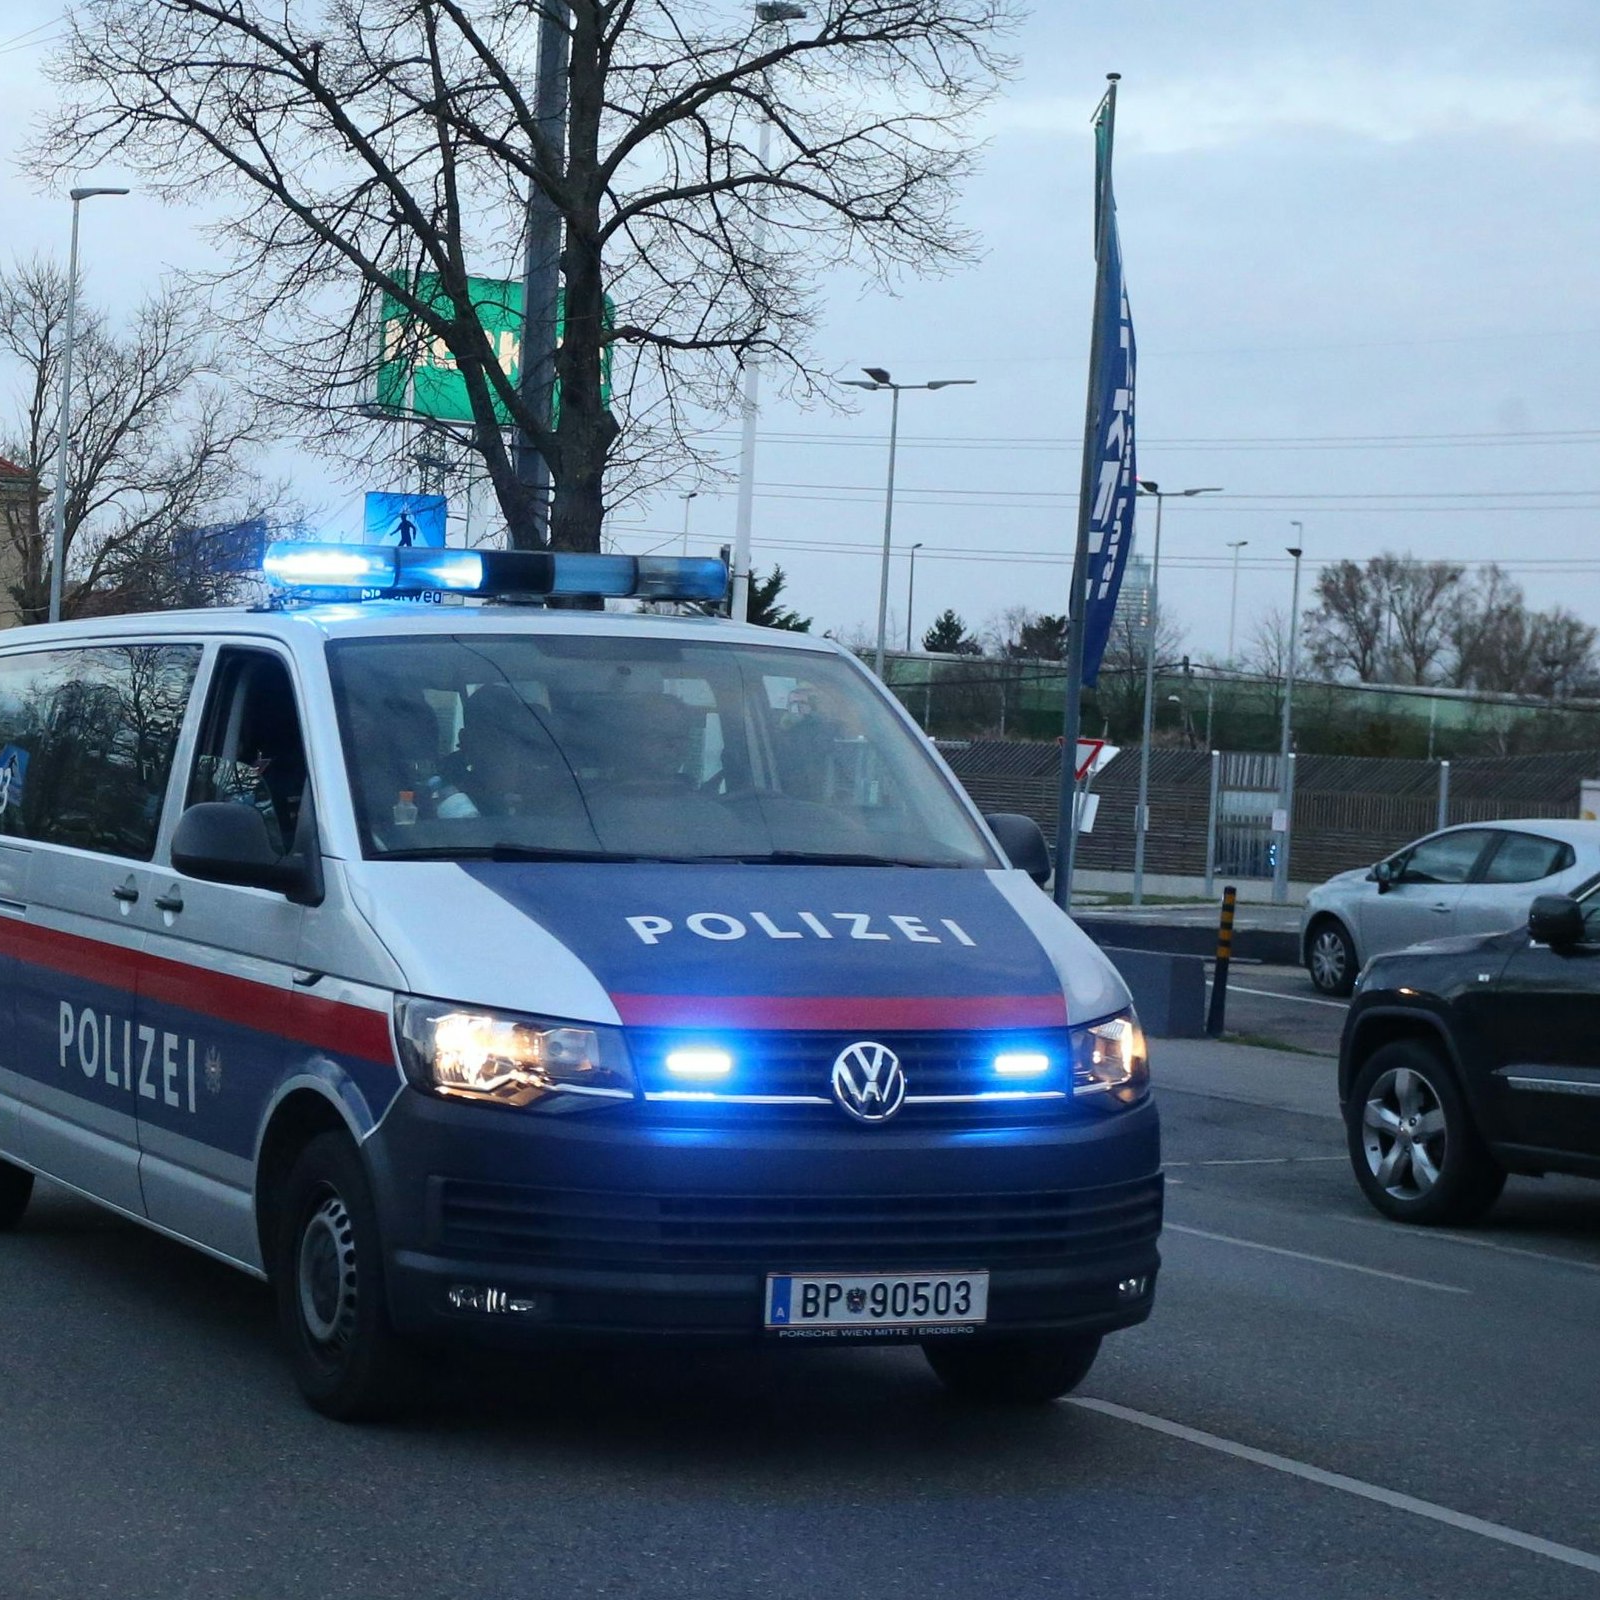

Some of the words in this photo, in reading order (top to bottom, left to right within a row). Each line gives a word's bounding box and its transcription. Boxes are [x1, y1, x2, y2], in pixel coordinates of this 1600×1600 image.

[625, 912, 977, 947] POLIZEI
[60, 1000, 197, 1114] POLIZEI
[802, 1283, 842, 1318] BP
[870, 1280, 971, 1318] 90503
[779, 1329, 838, 1338] PORSCHE
[874, 1327, 909, 1336] MITTE
[918, 1325, 975, 1336] ERDBERG
